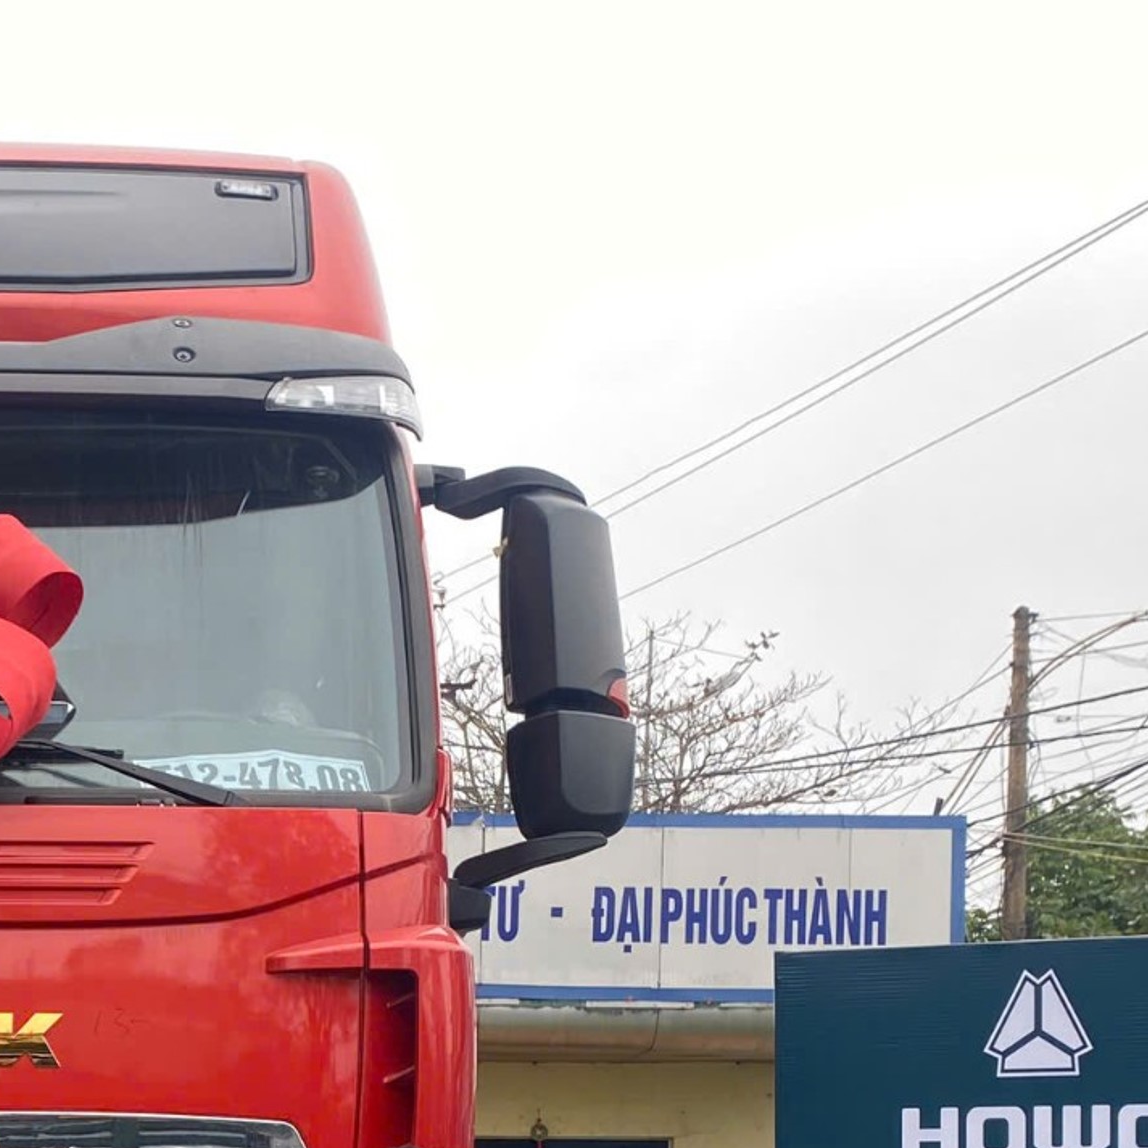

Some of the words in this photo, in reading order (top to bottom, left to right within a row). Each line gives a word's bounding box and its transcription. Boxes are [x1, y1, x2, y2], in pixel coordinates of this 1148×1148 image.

[151, 757, 366, 792] 12-478.08
[592, 885, 652, 953] ĐẠI
[661, 876, 757, 945] PHÚC
[763, 876, 888, 946] THÀNH
